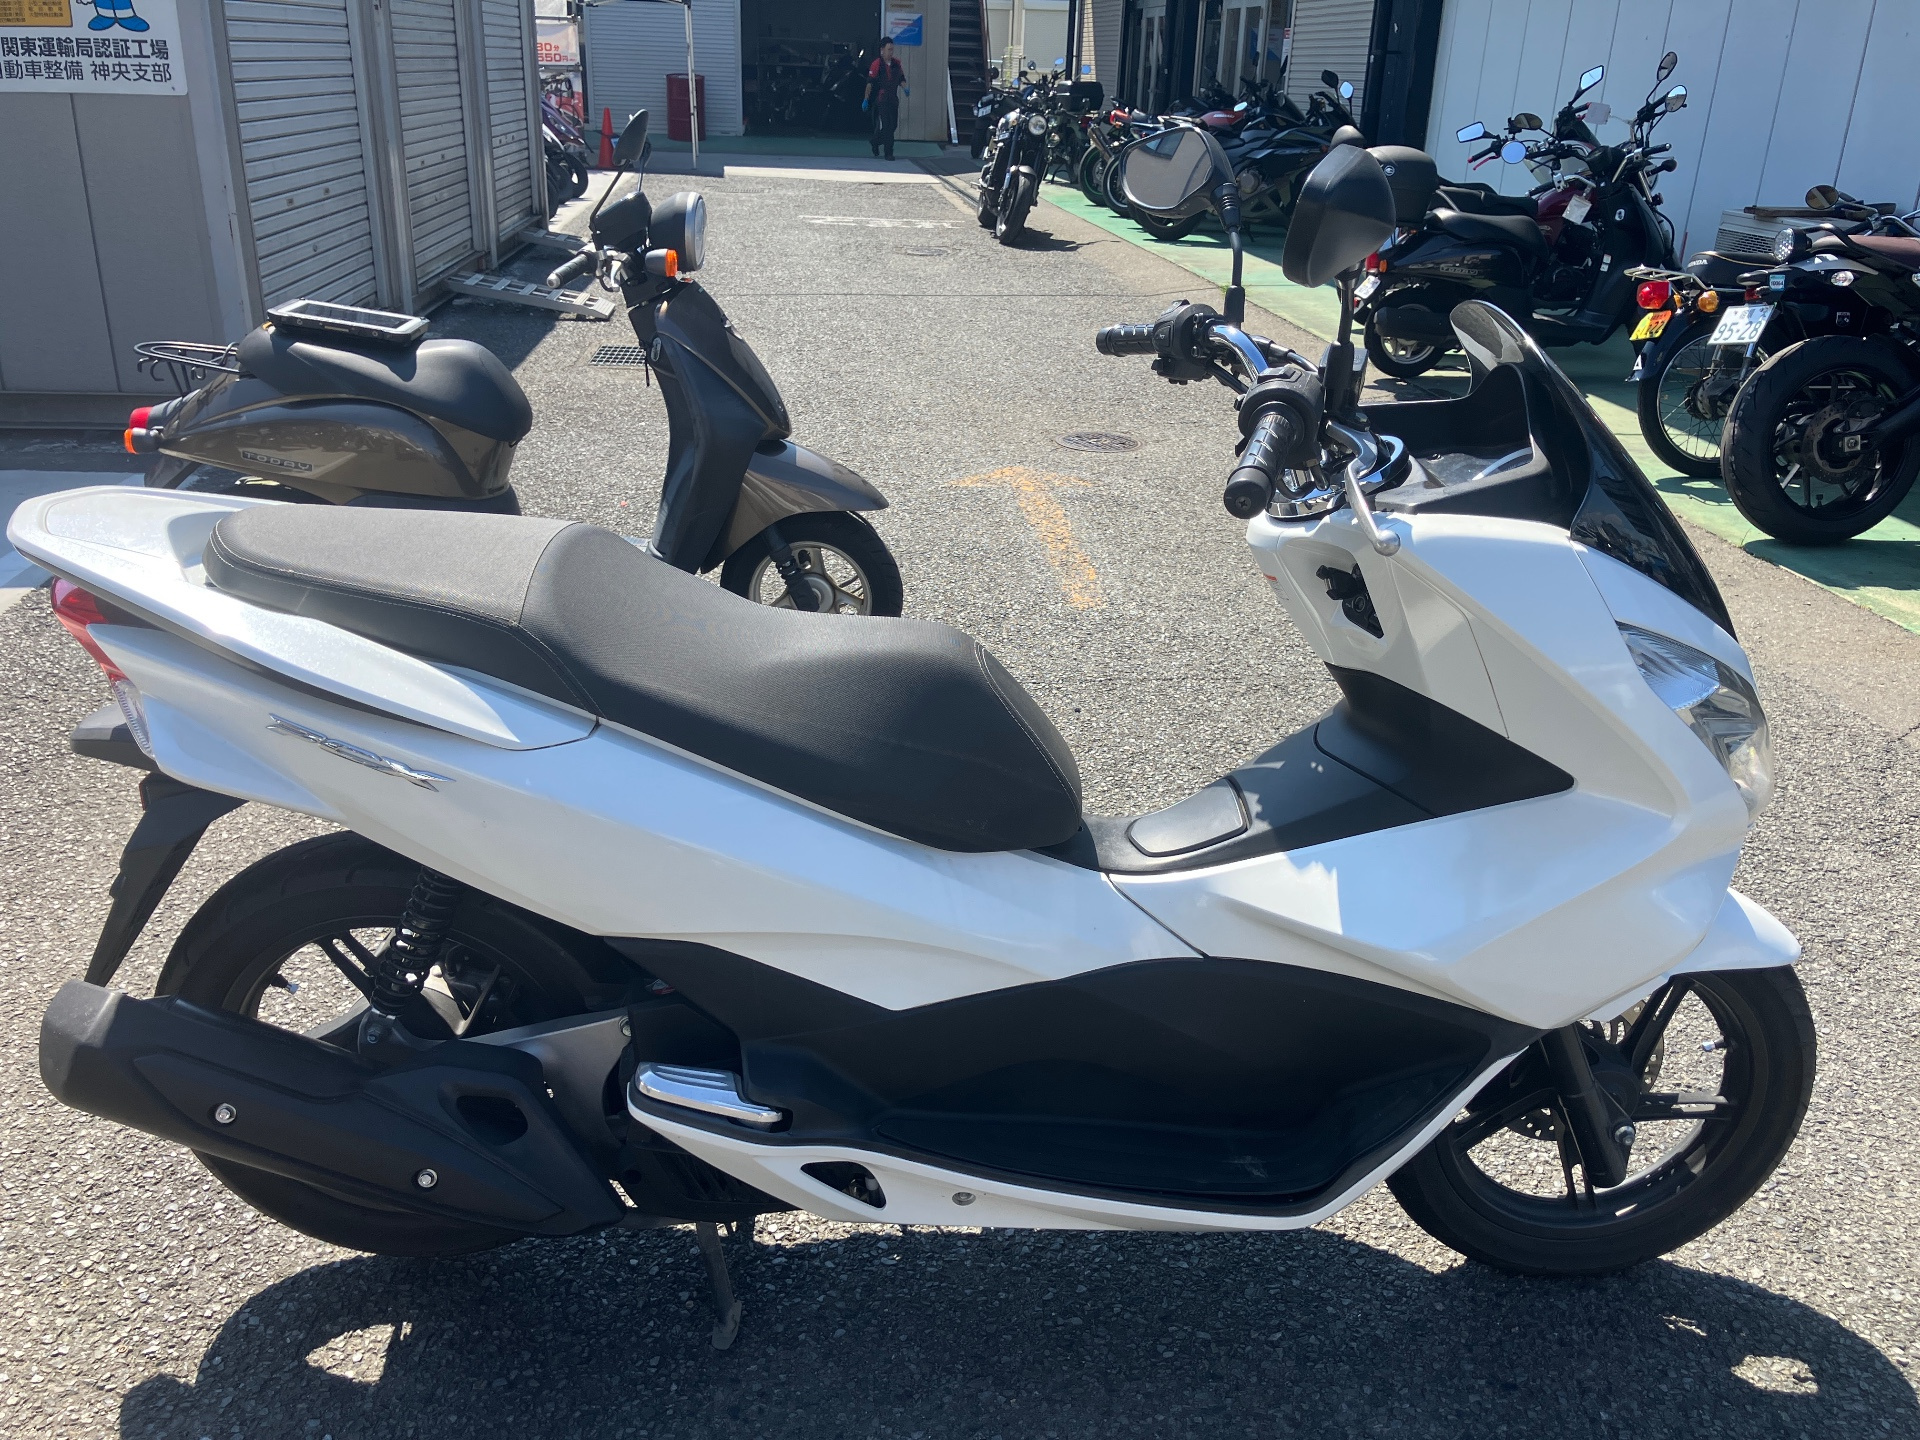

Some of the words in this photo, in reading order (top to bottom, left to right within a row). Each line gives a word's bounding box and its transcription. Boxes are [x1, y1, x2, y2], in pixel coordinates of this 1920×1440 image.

[1, 36, 169, 60] 関東運輸局認証工場
[0, 60, 84, 81] 動車整備
[90, 61, 172, 82] 神央支部
[243, 451, 310, 470] TODAY
